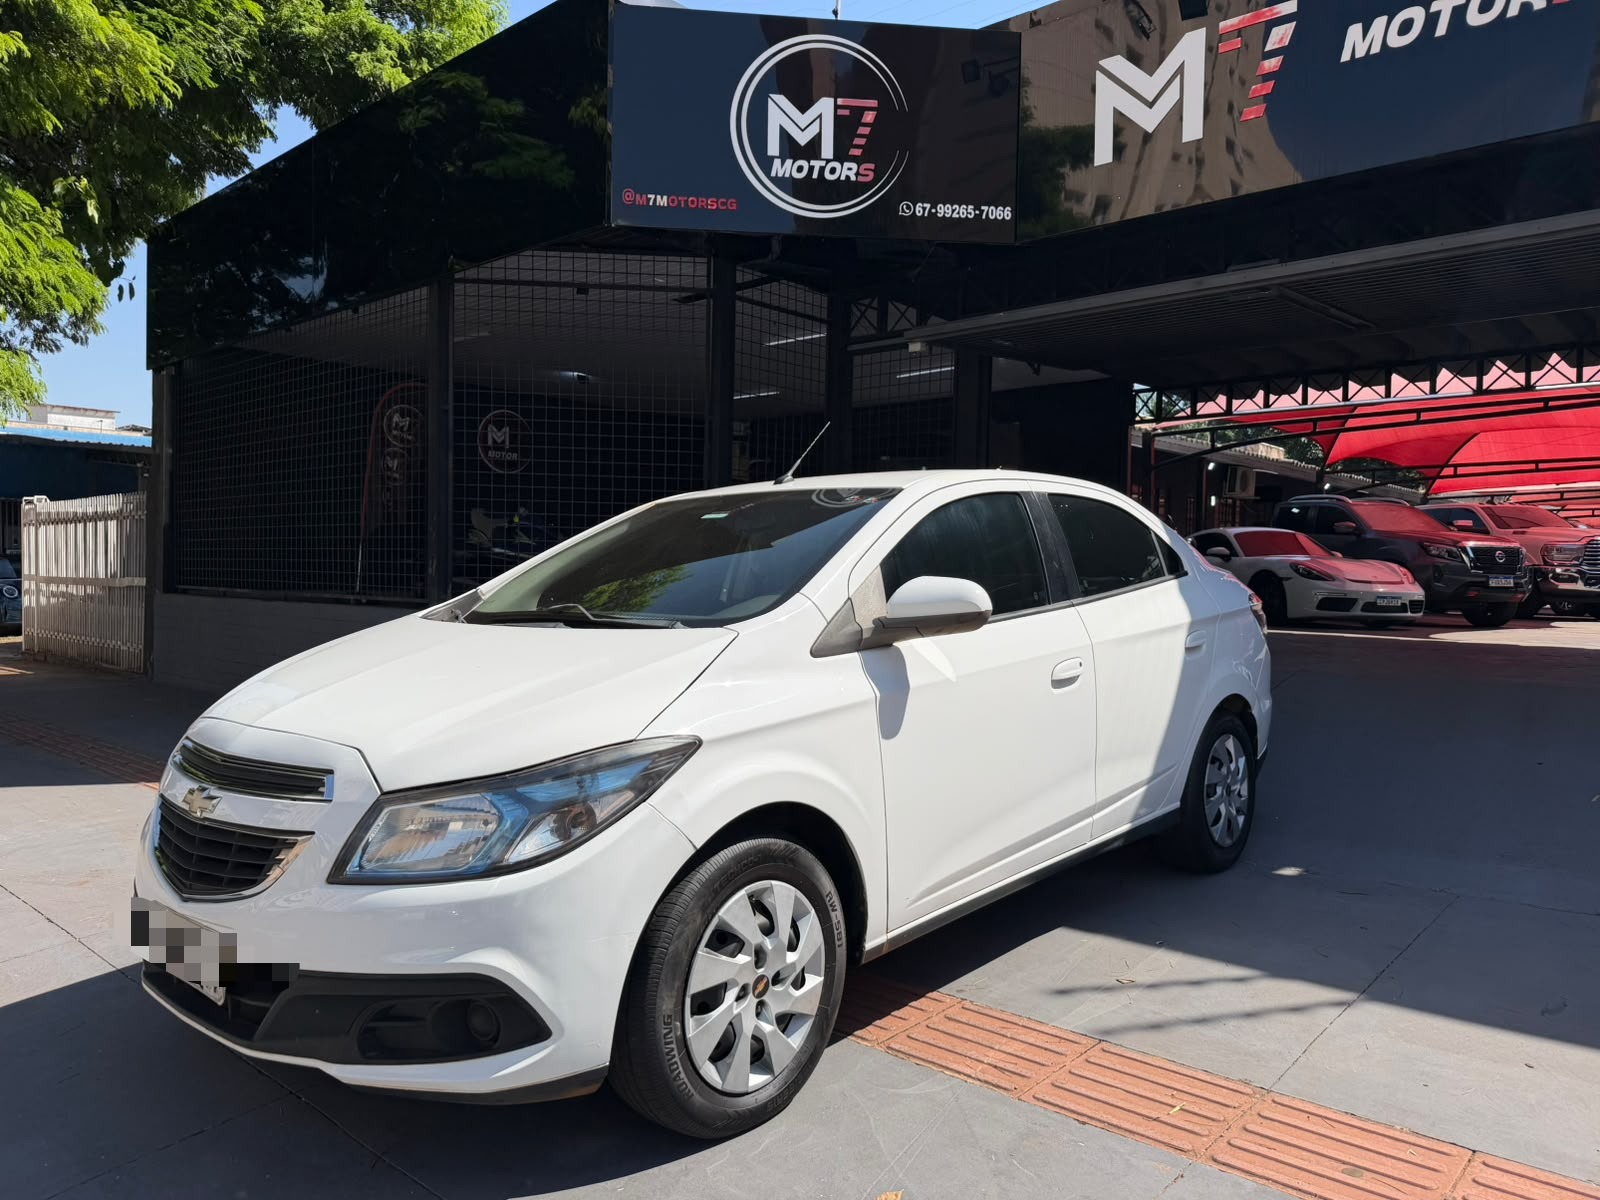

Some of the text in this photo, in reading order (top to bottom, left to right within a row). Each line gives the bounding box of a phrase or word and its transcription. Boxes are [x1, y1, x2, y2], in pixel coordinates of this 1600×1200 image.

[1341, 0, 1569, 63] MOTO
[767, 93, 878, 159] M7
[770, 158, 875, 182] MOTORS
[622, 188, 737, 210] @M7MOTORSCG
[915, 202, 1012, 220] 67-99265-7066
[662, 1014, 696, 1100] ROADWING
